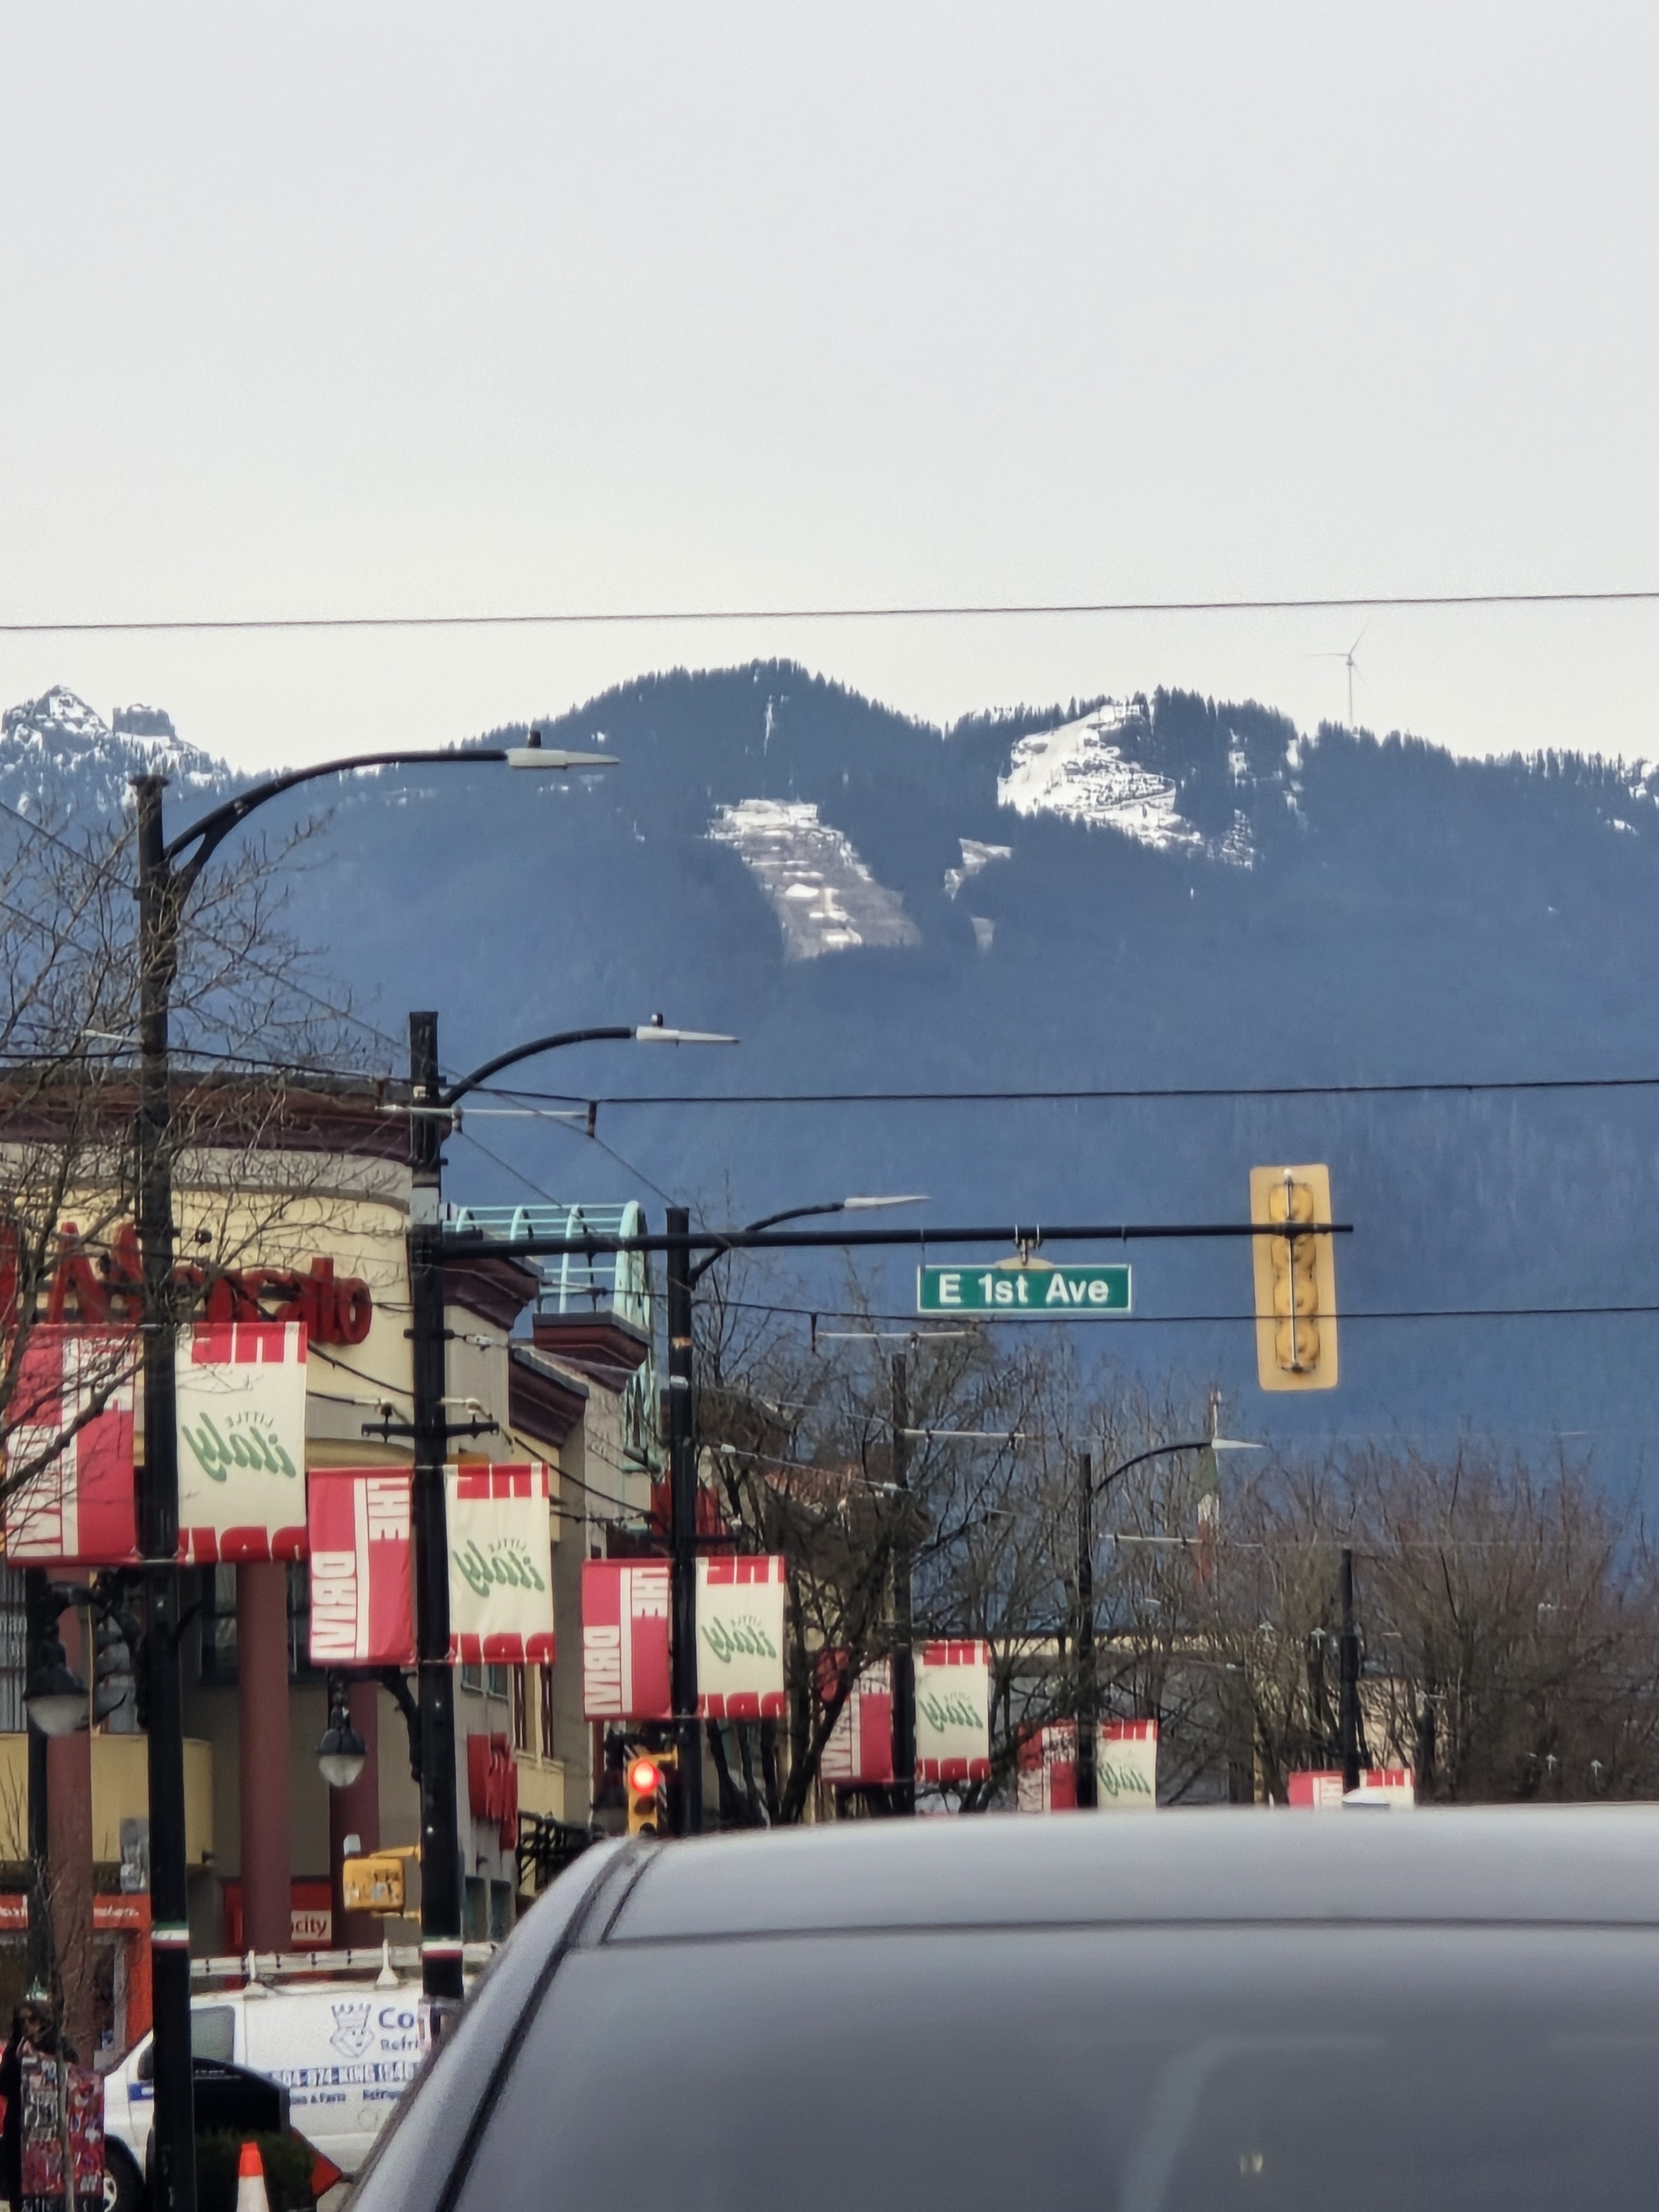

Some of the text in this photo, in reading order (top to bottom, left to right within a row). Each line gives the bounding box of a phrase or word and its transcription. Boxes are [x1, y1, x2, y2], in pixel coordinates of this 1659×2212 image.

[940, 1273, 1109, 1303] E 1st Ave
[291, 1916, 327, 1938] city
[378, 2007, 415, 2030] Co
[380, 2035, 419, 2051] Refri
